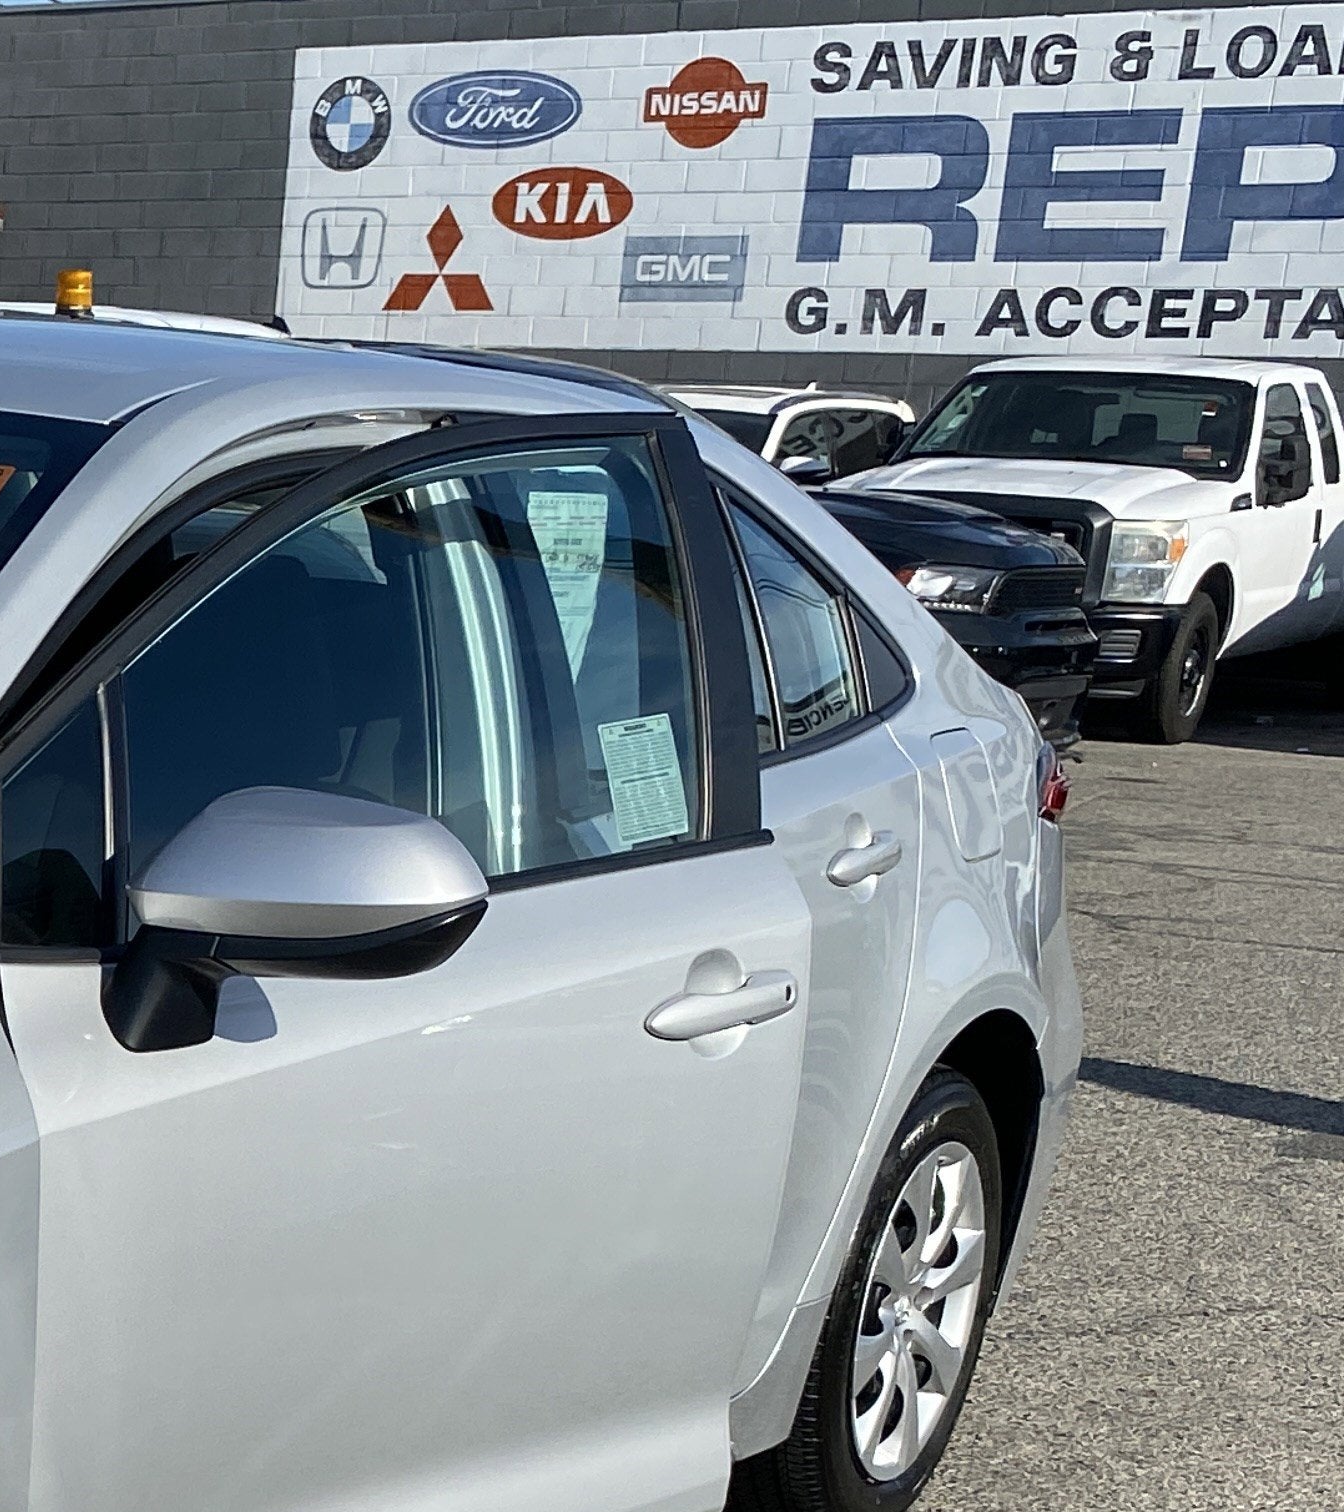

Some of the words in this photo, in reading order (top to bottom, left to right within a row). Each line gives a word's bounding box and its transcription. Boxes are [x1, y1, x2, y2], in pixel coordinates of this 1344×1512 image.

[810, 33, 1078, 93] SAVING
[1109, 30, 1154, 82] &
[1178, 24, 1344, 80] LOA
[444, 86, 541, 130] Ford
[649, 89, 760, 116] NISSAN
[513, 182, 613, 224] KIA
[635, 254, 732, 283] GMC
[784, 286, 946, 337] G.M.
